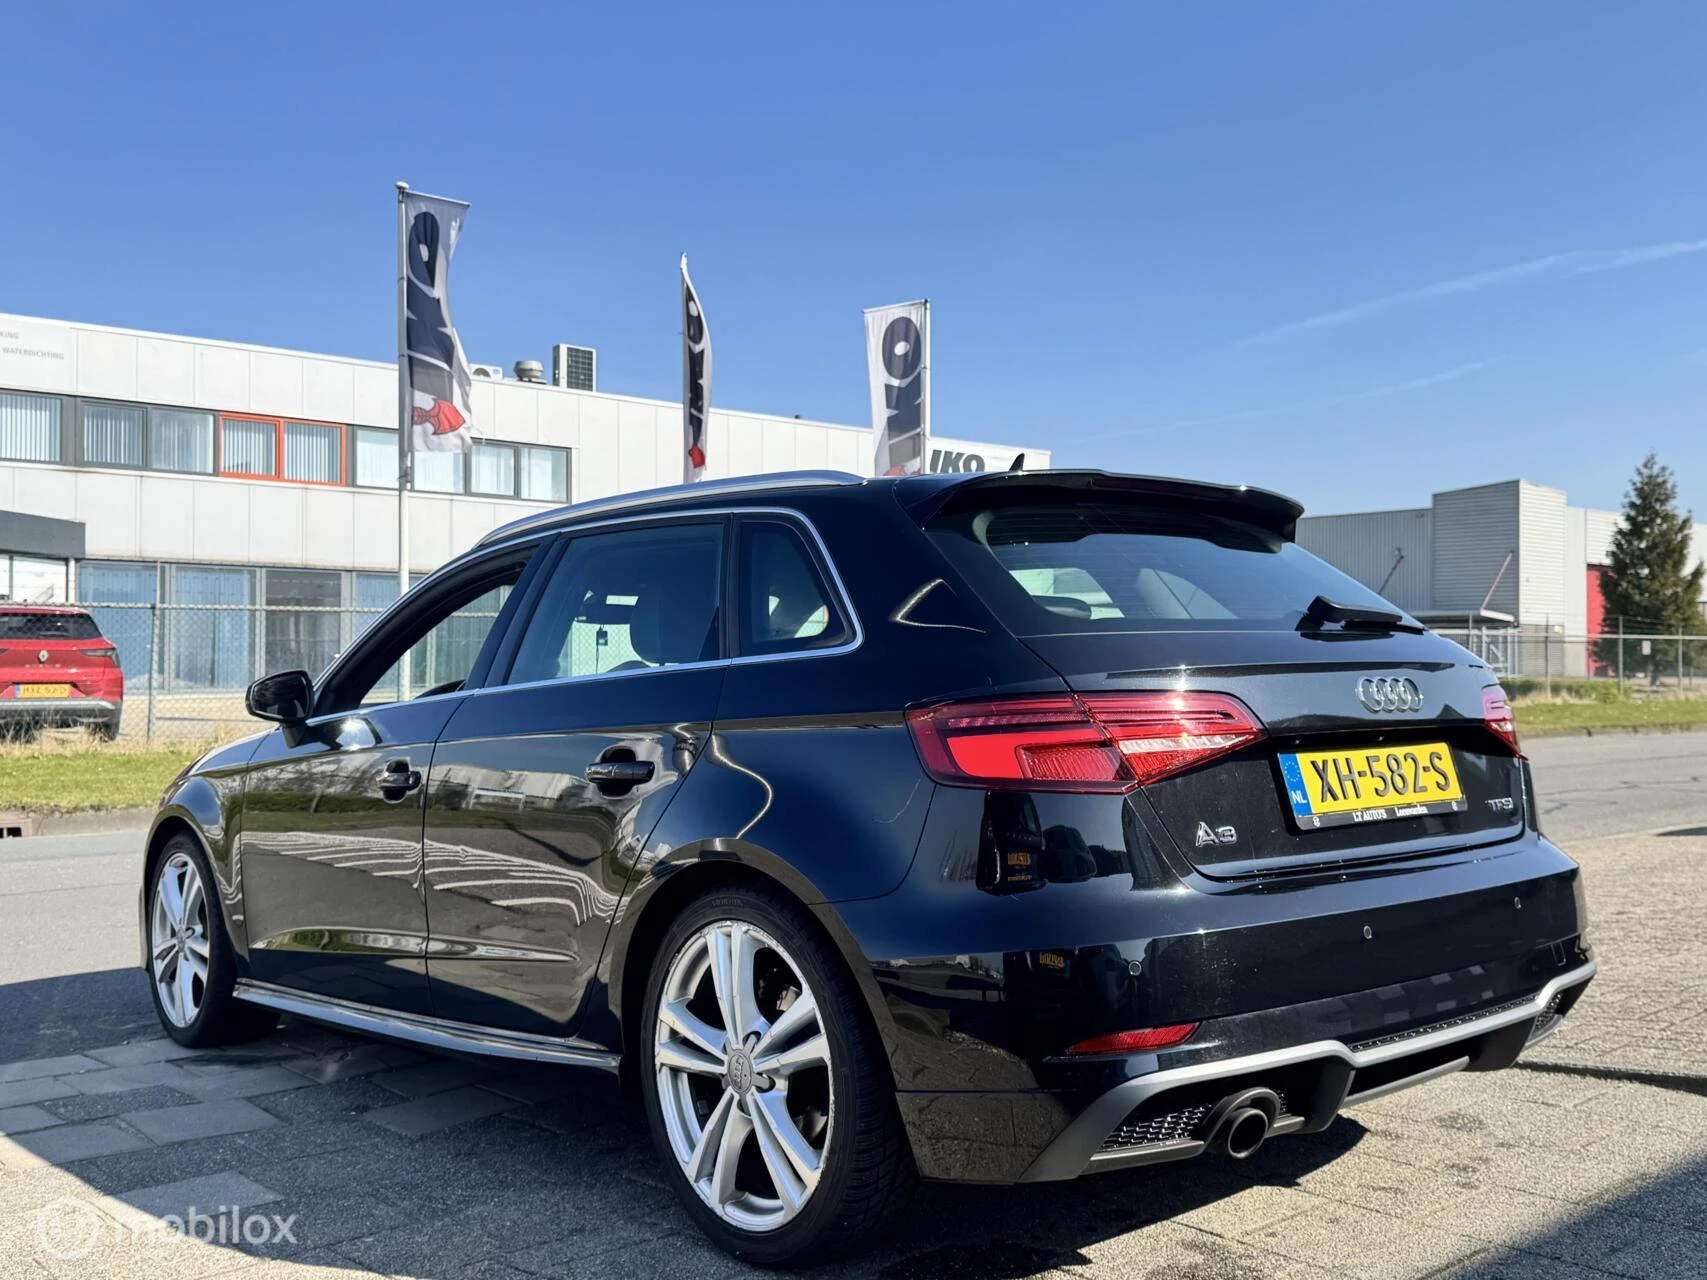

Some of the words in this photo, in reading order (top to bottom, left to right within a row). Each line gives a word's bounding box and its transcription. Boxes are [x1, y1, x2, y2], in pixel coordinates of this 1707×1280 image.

[930, 449, 985, 473] IKO
[1310, 751, 1451, 802] XH-582-S
[1291, 790, 1308, 804] NL
[1484, 797, 1514, 812] TFSI
[1195, 821, 1238, 848] A3
